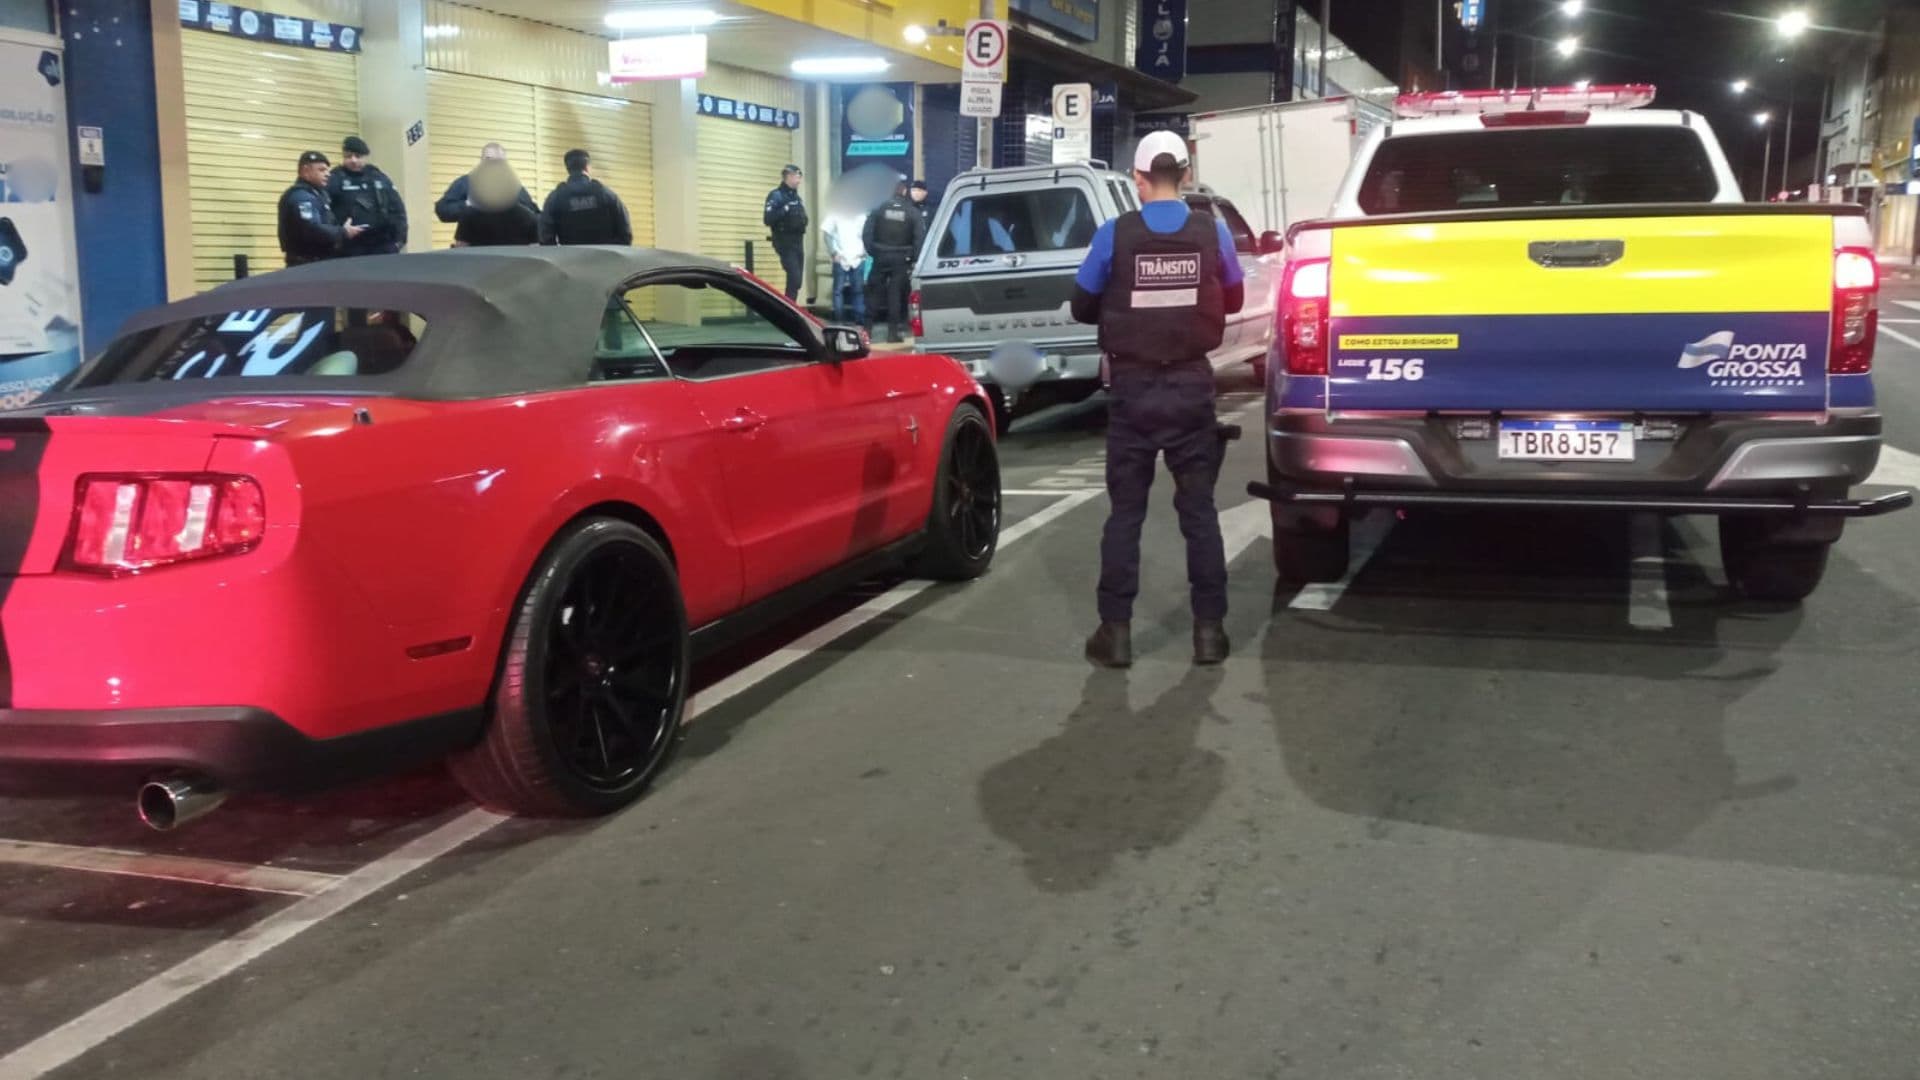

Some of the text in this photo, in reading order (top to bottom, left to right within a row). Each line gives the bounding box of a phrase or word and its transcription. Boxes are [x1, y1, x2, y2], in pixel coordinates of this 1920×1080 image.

[977, 31, 993, 58] E
[1065, 94, 1079, 116] E
[936, 259, 960, 269] S10
[1140, 257, 1196, 275] TRÂNSITO
[1344, 338, 1372, 346] COMO
[1372, 338, 1400, 346] ESTOU
[1727, 343, 1807, 360] PONTA
[1366, 358, 1425, 381] 156
[1707, 361, 1802, 377] GROSSA
[1710, 379, 1805, 387] PREFEITURA
[1510, 432, 1619, 455] TBR8J57
